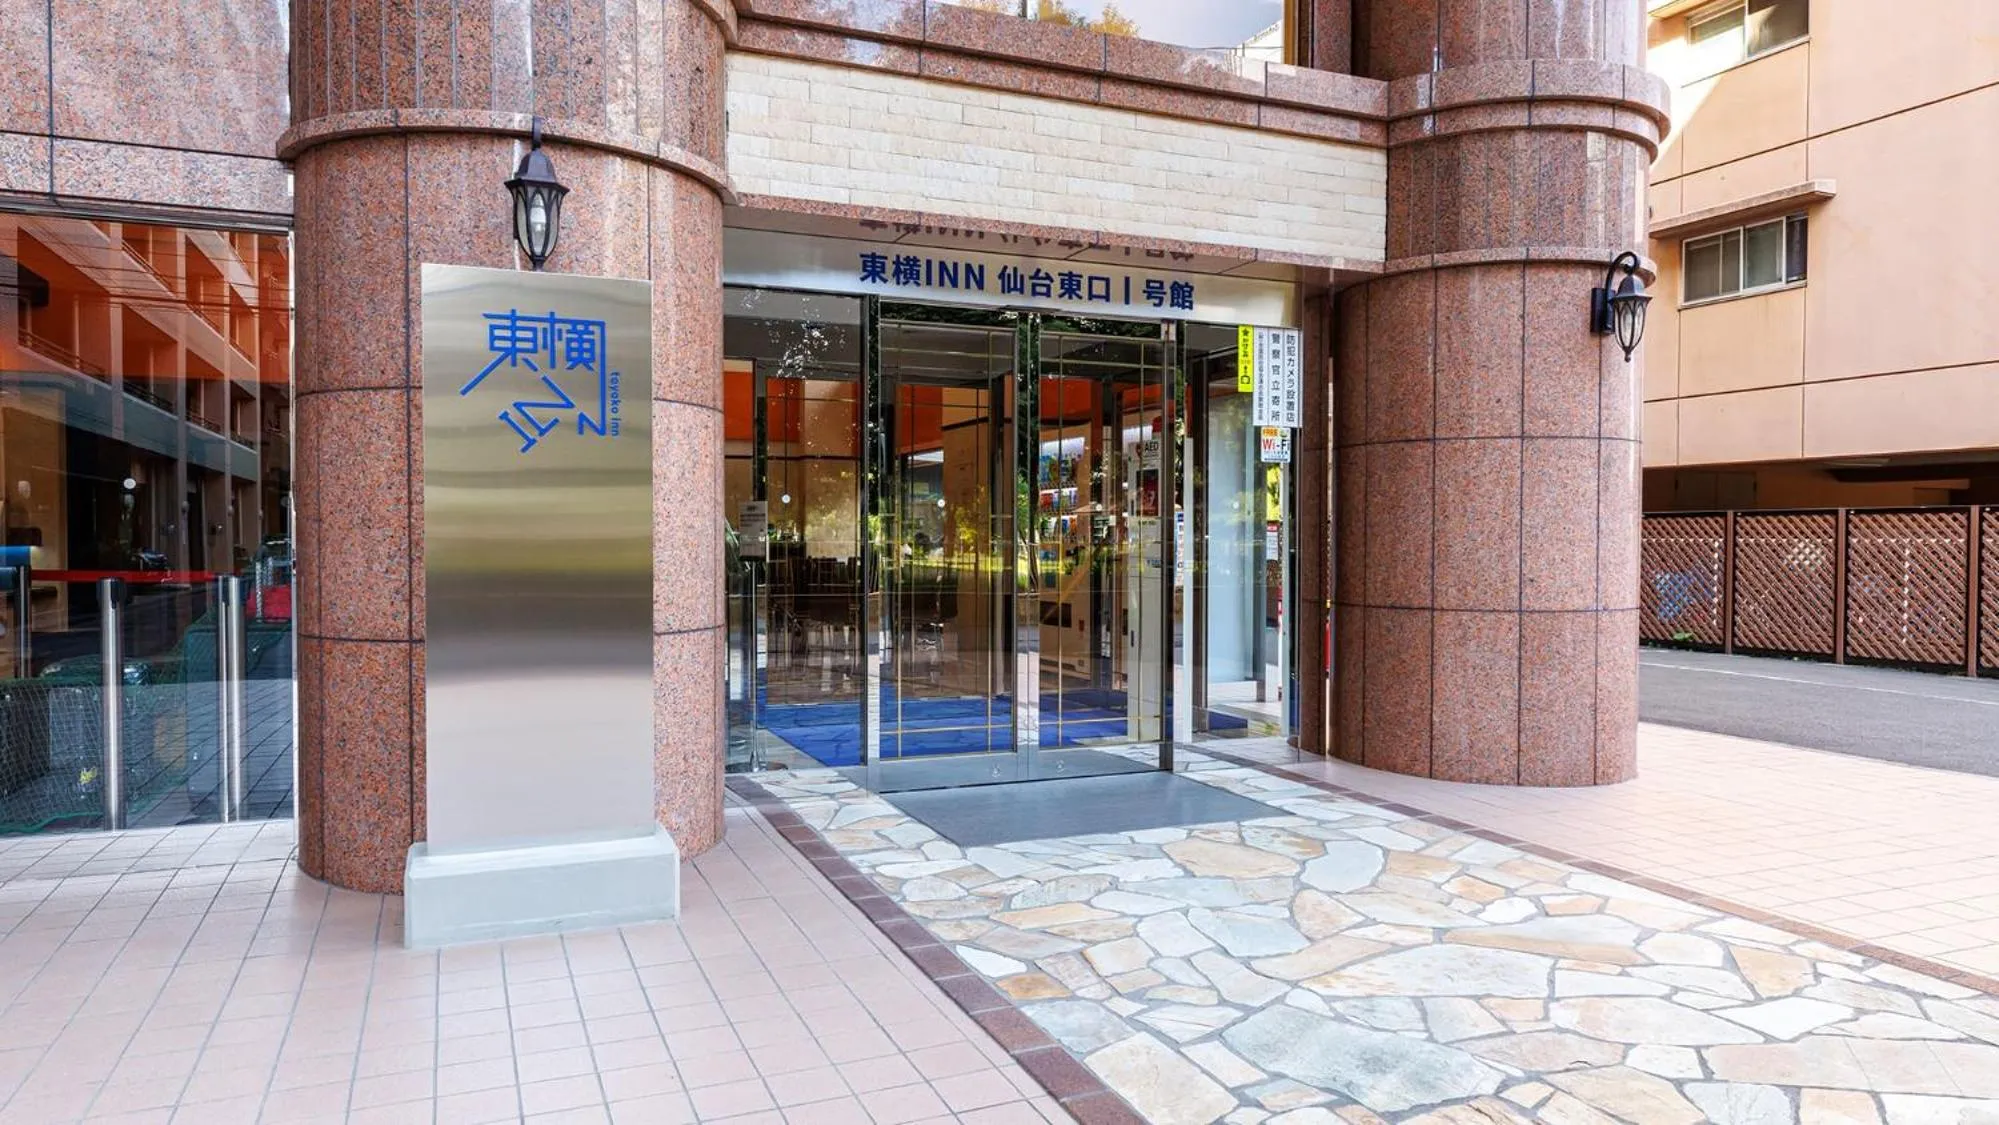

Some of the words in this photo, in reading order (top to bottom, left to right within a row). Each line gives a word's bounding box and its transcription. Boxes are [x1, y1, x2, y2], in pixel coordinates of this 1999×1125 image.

[859, 252, 985, 291] 東横INN
[608, 371, 621, 414] toyoko
[1271, 333, 1281, 421] 警察官立寄所
[1286, 334, 1296, 422] 防犯カメラ設置店
[610, 418, 622, 437] inn
[1144, 442, 1159, 452] AED
[1262, 438, 1290, 451] Wi-Fi
